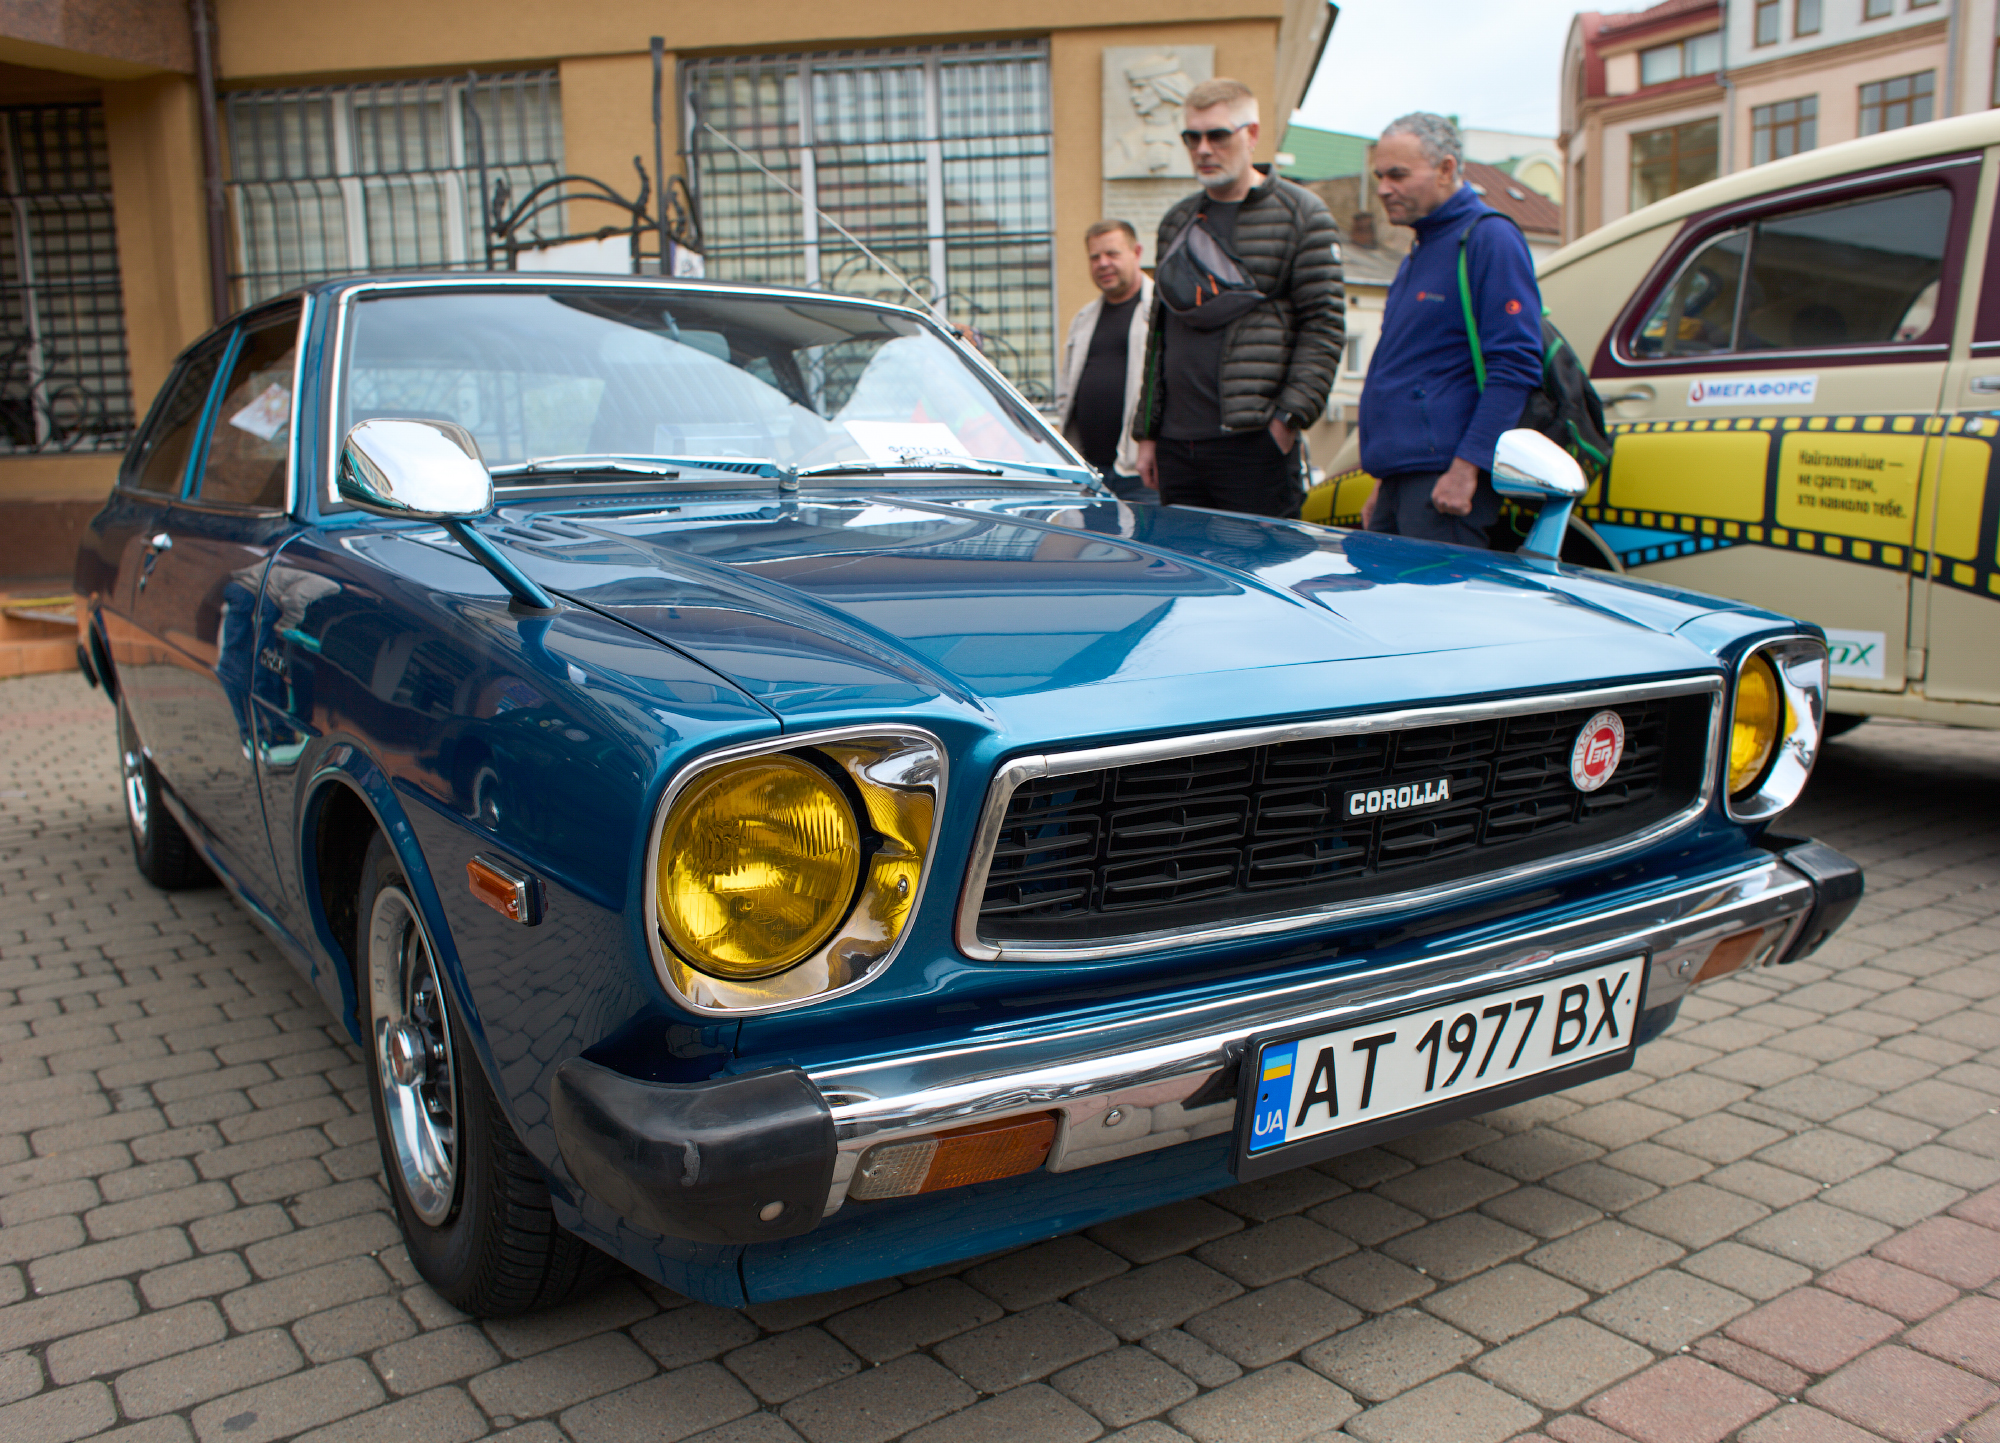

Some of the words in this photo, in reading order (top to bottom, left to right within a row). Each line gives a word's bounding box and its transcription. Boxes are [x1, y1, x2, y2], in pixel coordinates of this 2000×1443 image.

[1707, 381, 1813, 397] МЕГАФОРС
[1798, 449, 1885, 471] Найголовніше
[1797, 474, 1811, 487] не
[1818, 496, 1870, 514] навколо
[1349, 778, 1450, 816] COROLLA
[1294, 1031, 1397, 1128] AT
[1415, 994, 1545, 1093] 1977
[1550, 971, 1630, 1057] BX
[1254, 1109, 1284, 1136] UA
